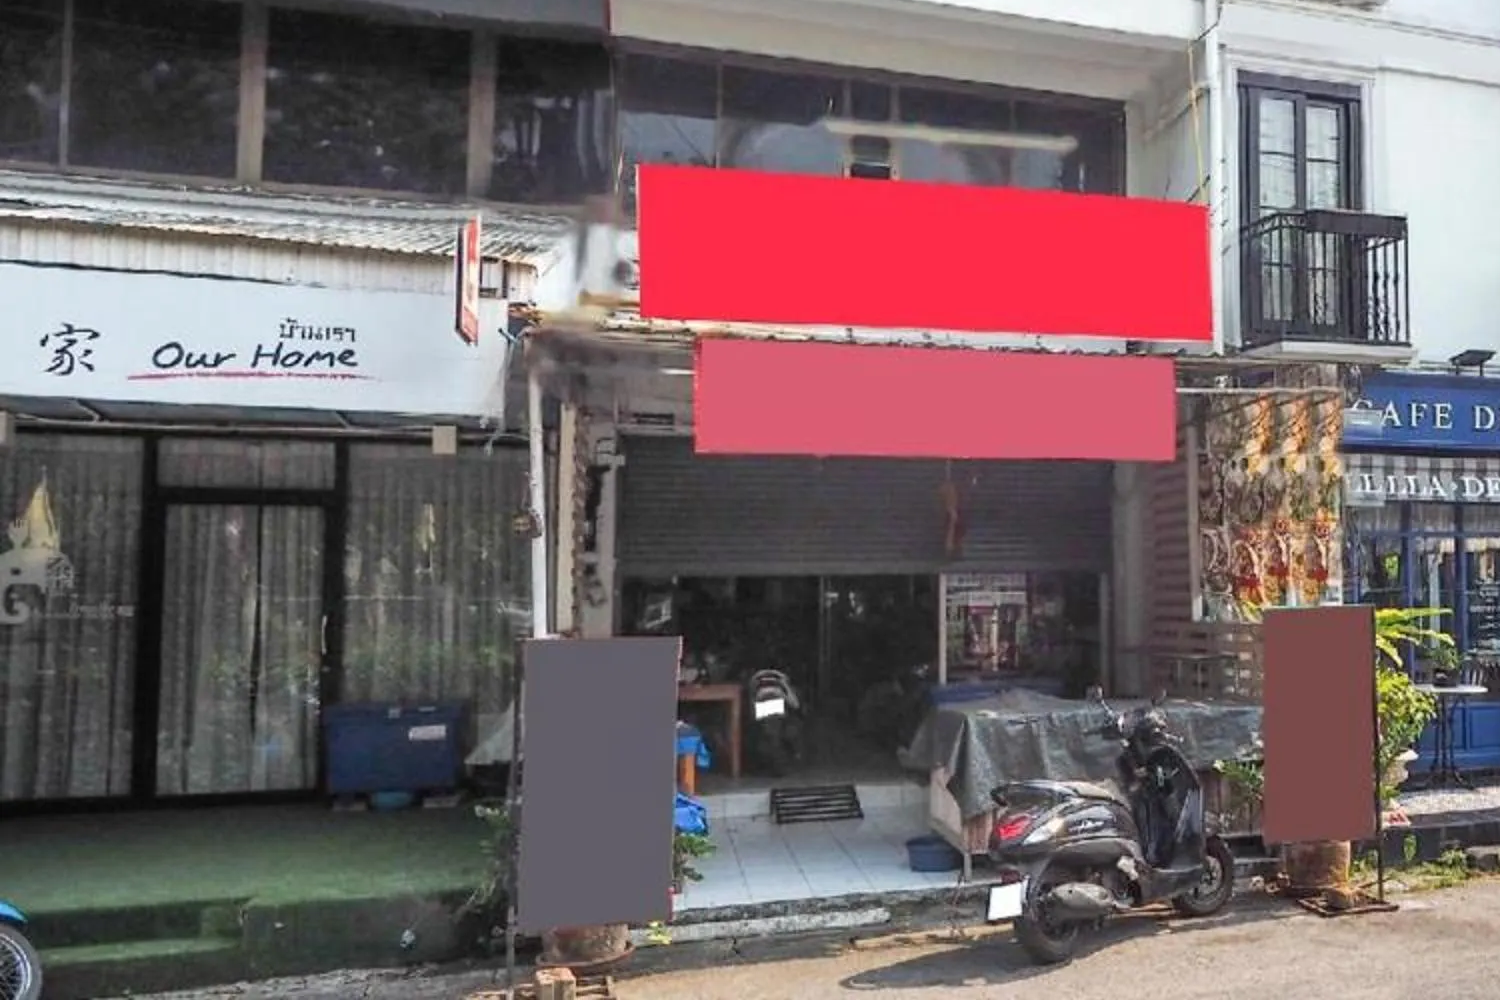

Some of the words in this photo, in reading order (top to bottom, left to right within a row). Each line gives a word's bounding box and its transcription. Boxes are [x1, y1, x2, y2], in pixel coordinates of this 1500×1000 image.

[279, 317, 356, 342] บ้านเรา
[40, 323, 101, 376] 家
[152, 341, 237, 369] Our
[252, 343, 359, 369] Home
